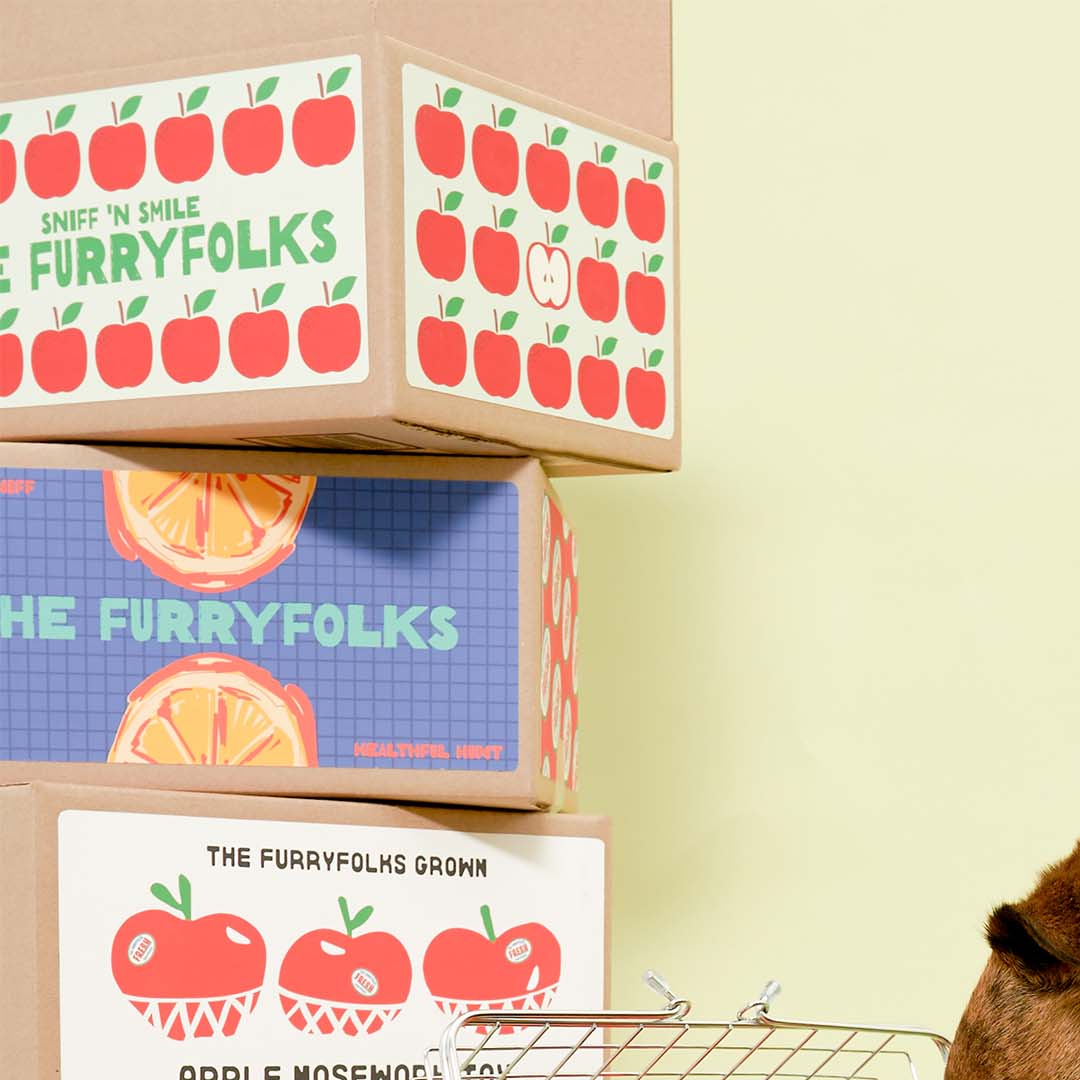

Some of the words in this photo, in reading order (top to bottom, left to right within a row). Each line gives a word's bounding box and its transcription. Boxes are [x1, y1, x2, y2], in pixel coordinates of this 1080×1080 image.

[41, 207, 98, 234] SNIFF
[107, 203, 129, 226] 'N
[139, 196, 200, 223] SMILE
[30, 209, 337, 290] FURRYFOLKS
[0, 595, 76, 640] HE
[100, 597, 459, 651] FURRYFOLKS
[207, 845, 250, 868] THE
[260, 848, 406, 874] FURRYFOLKS
[415, 855, 487, 877] GROWN
